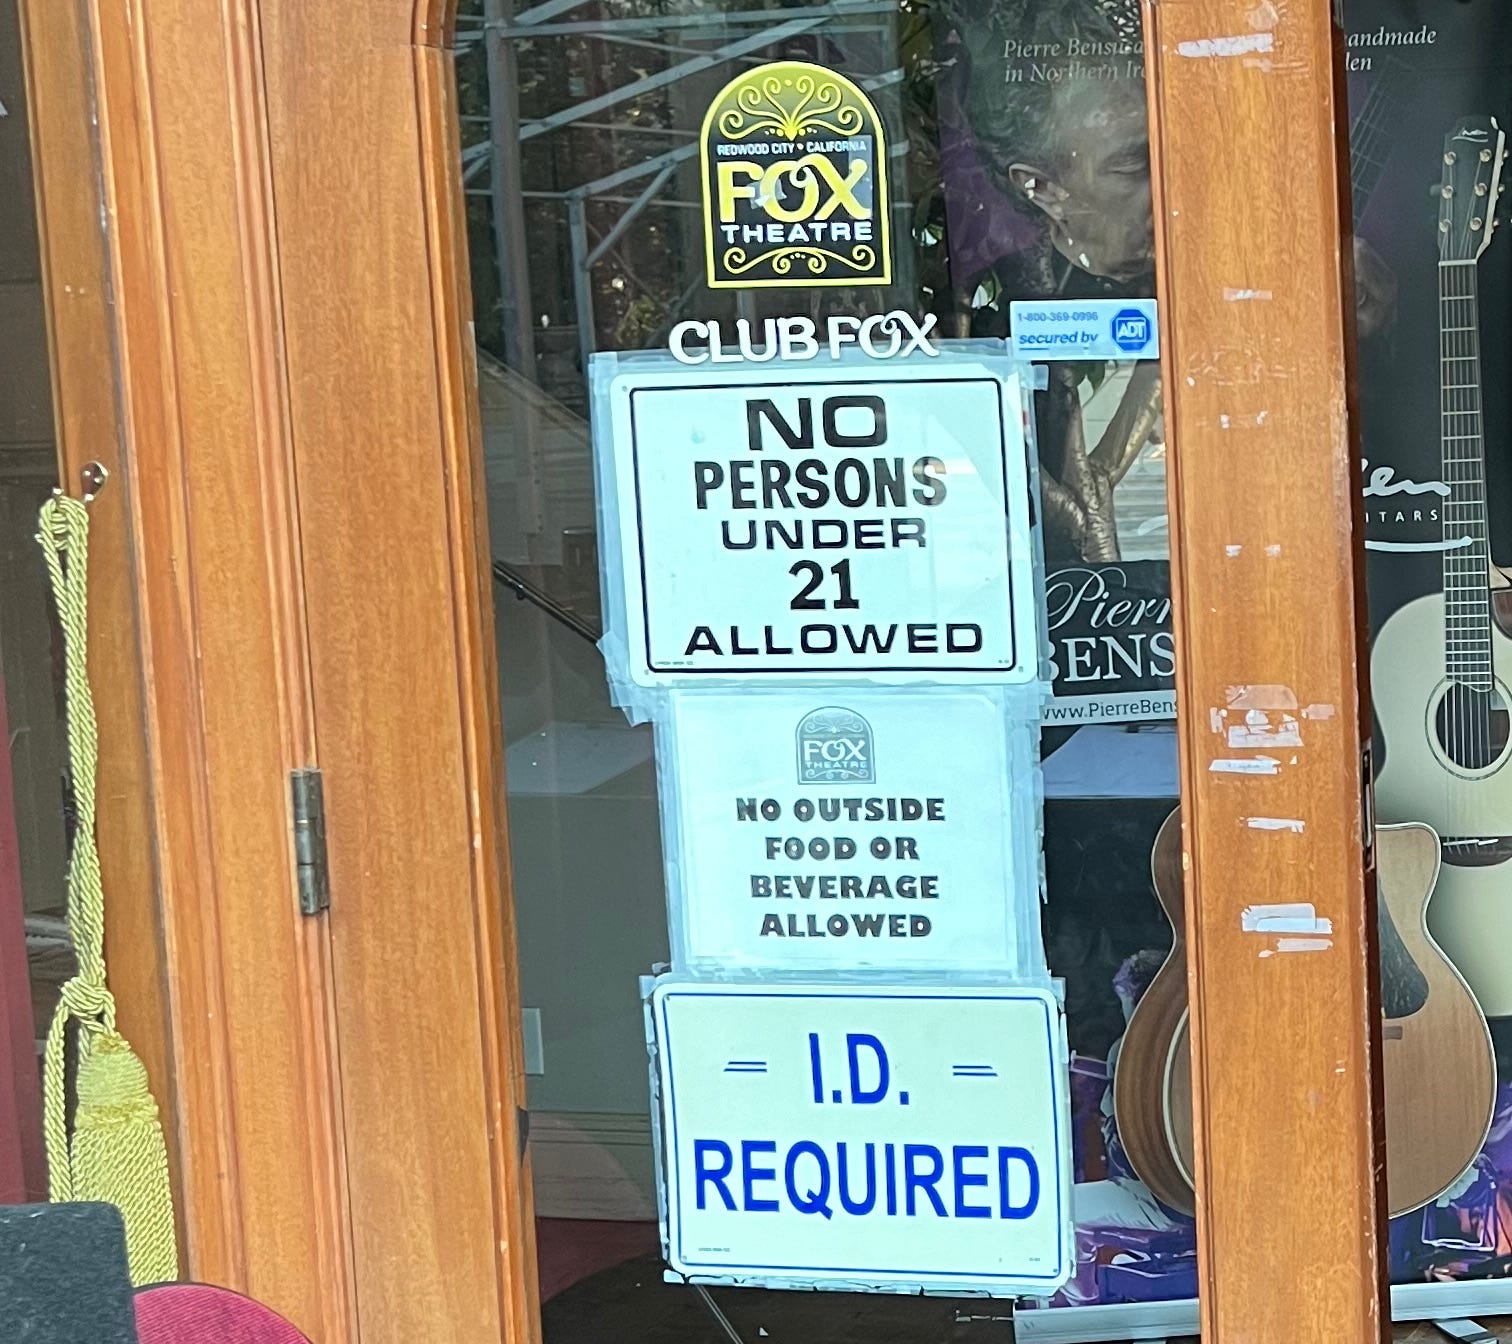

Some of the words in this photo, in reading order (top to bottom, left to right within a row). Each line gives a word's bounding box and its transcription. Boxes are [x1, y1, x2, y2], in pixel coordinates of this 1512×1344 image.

[1004, 40, 1061, 58] Pierre
[1345, 24, 1437, 47] andmade
[1005, 65, 1023, 82] in
[1030, 62, 1119, 82] Northern
[717, 142, 769, 156] REDWOOD
[771, 141, 795, 154] CITY
[806, 140, 867, 153] CALIFORNIA
[717, 153, 872, 223] FOX
[720, 221, 873, 244] THEATRE
[668, 317, 821, 364] CLUB
[827, 309, 939, 360] FOX
[1019, 332, 1078, 344] secured
[1118, 321, 1146, 339] ADT
[746, 395, 888, 451] NO
[694, 456, 947, 509] PERSONS
[721, 518, 927, 550] UNDER
[789, 559, 860, 610] 21
[684, 623, 984, 657] ALLOWED
[803, 738, 867, 762] FOX
[805, 761, 867, 769] THEATRE
[736, 797, 781, 823] NO
[793, 797, 946, 822] OUTSIDE
[765, 837, 858, 860] FOOD
[869, 837, 919, 860] OR
[751, 875, 940, 899] BEVERAGE
[759, 914, 932, 938] ALLOWED
[808, 1032, 910, 1106] I.D.
[693, 1138, 1041, 1220] REQUIRED
